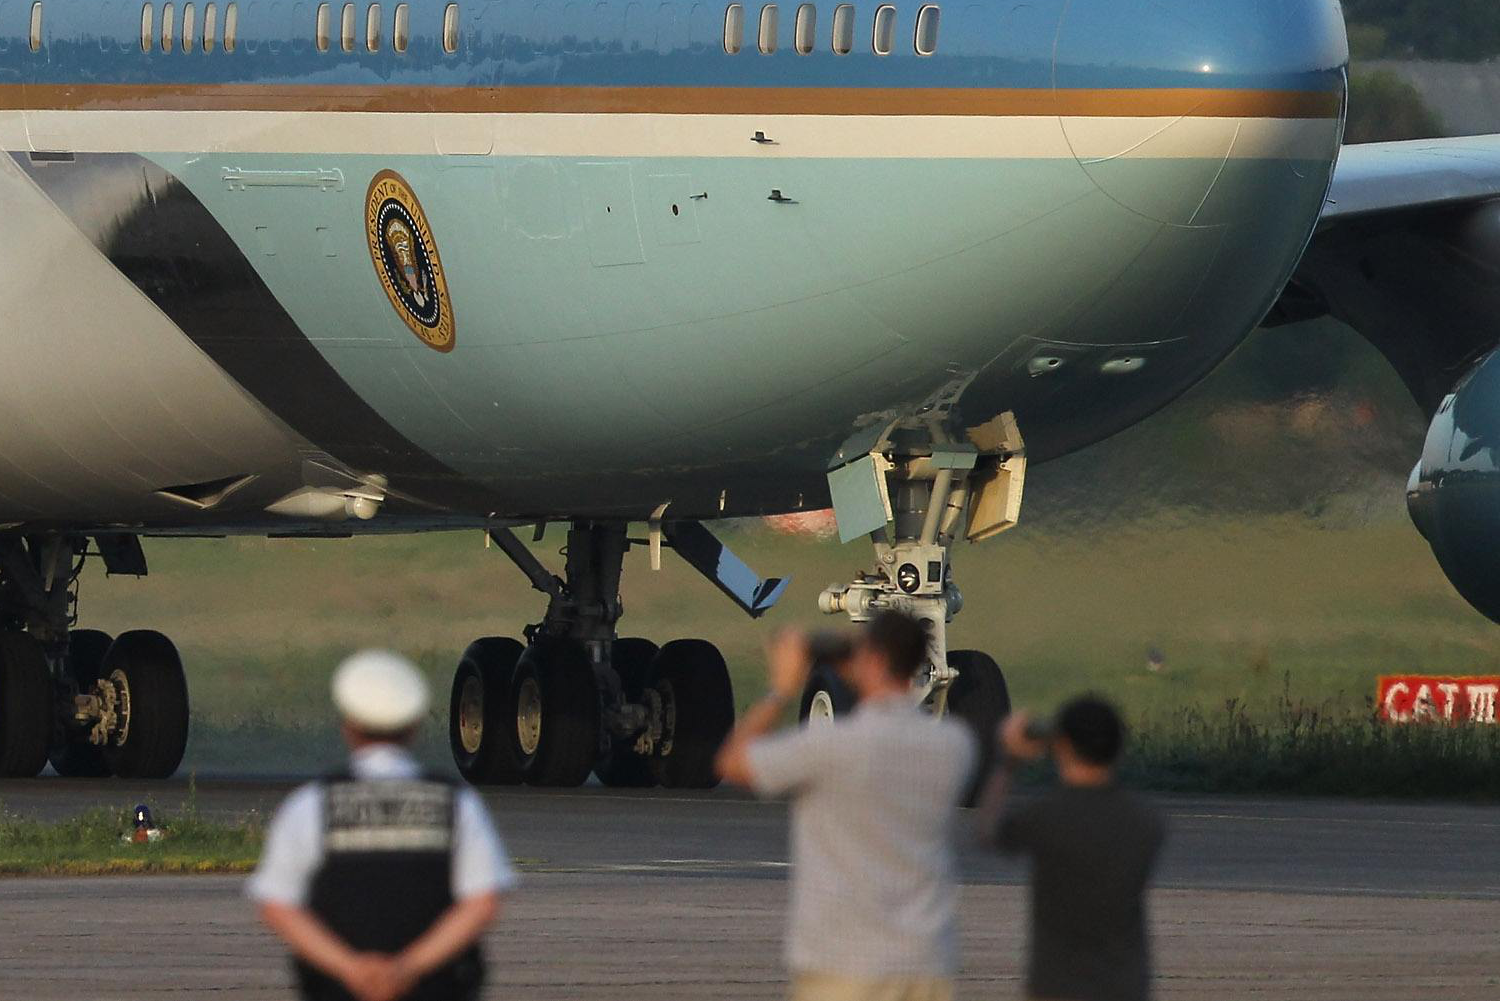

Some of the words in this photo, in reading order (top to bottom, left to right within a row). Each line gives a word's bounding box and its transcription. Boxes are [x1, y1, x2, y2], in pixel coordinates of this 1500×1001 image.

[368, 181, 389, 261] PRESIDENT
[409, 202, 440, 277] UNITED
[1385, 681, 1460, 723] CAT
